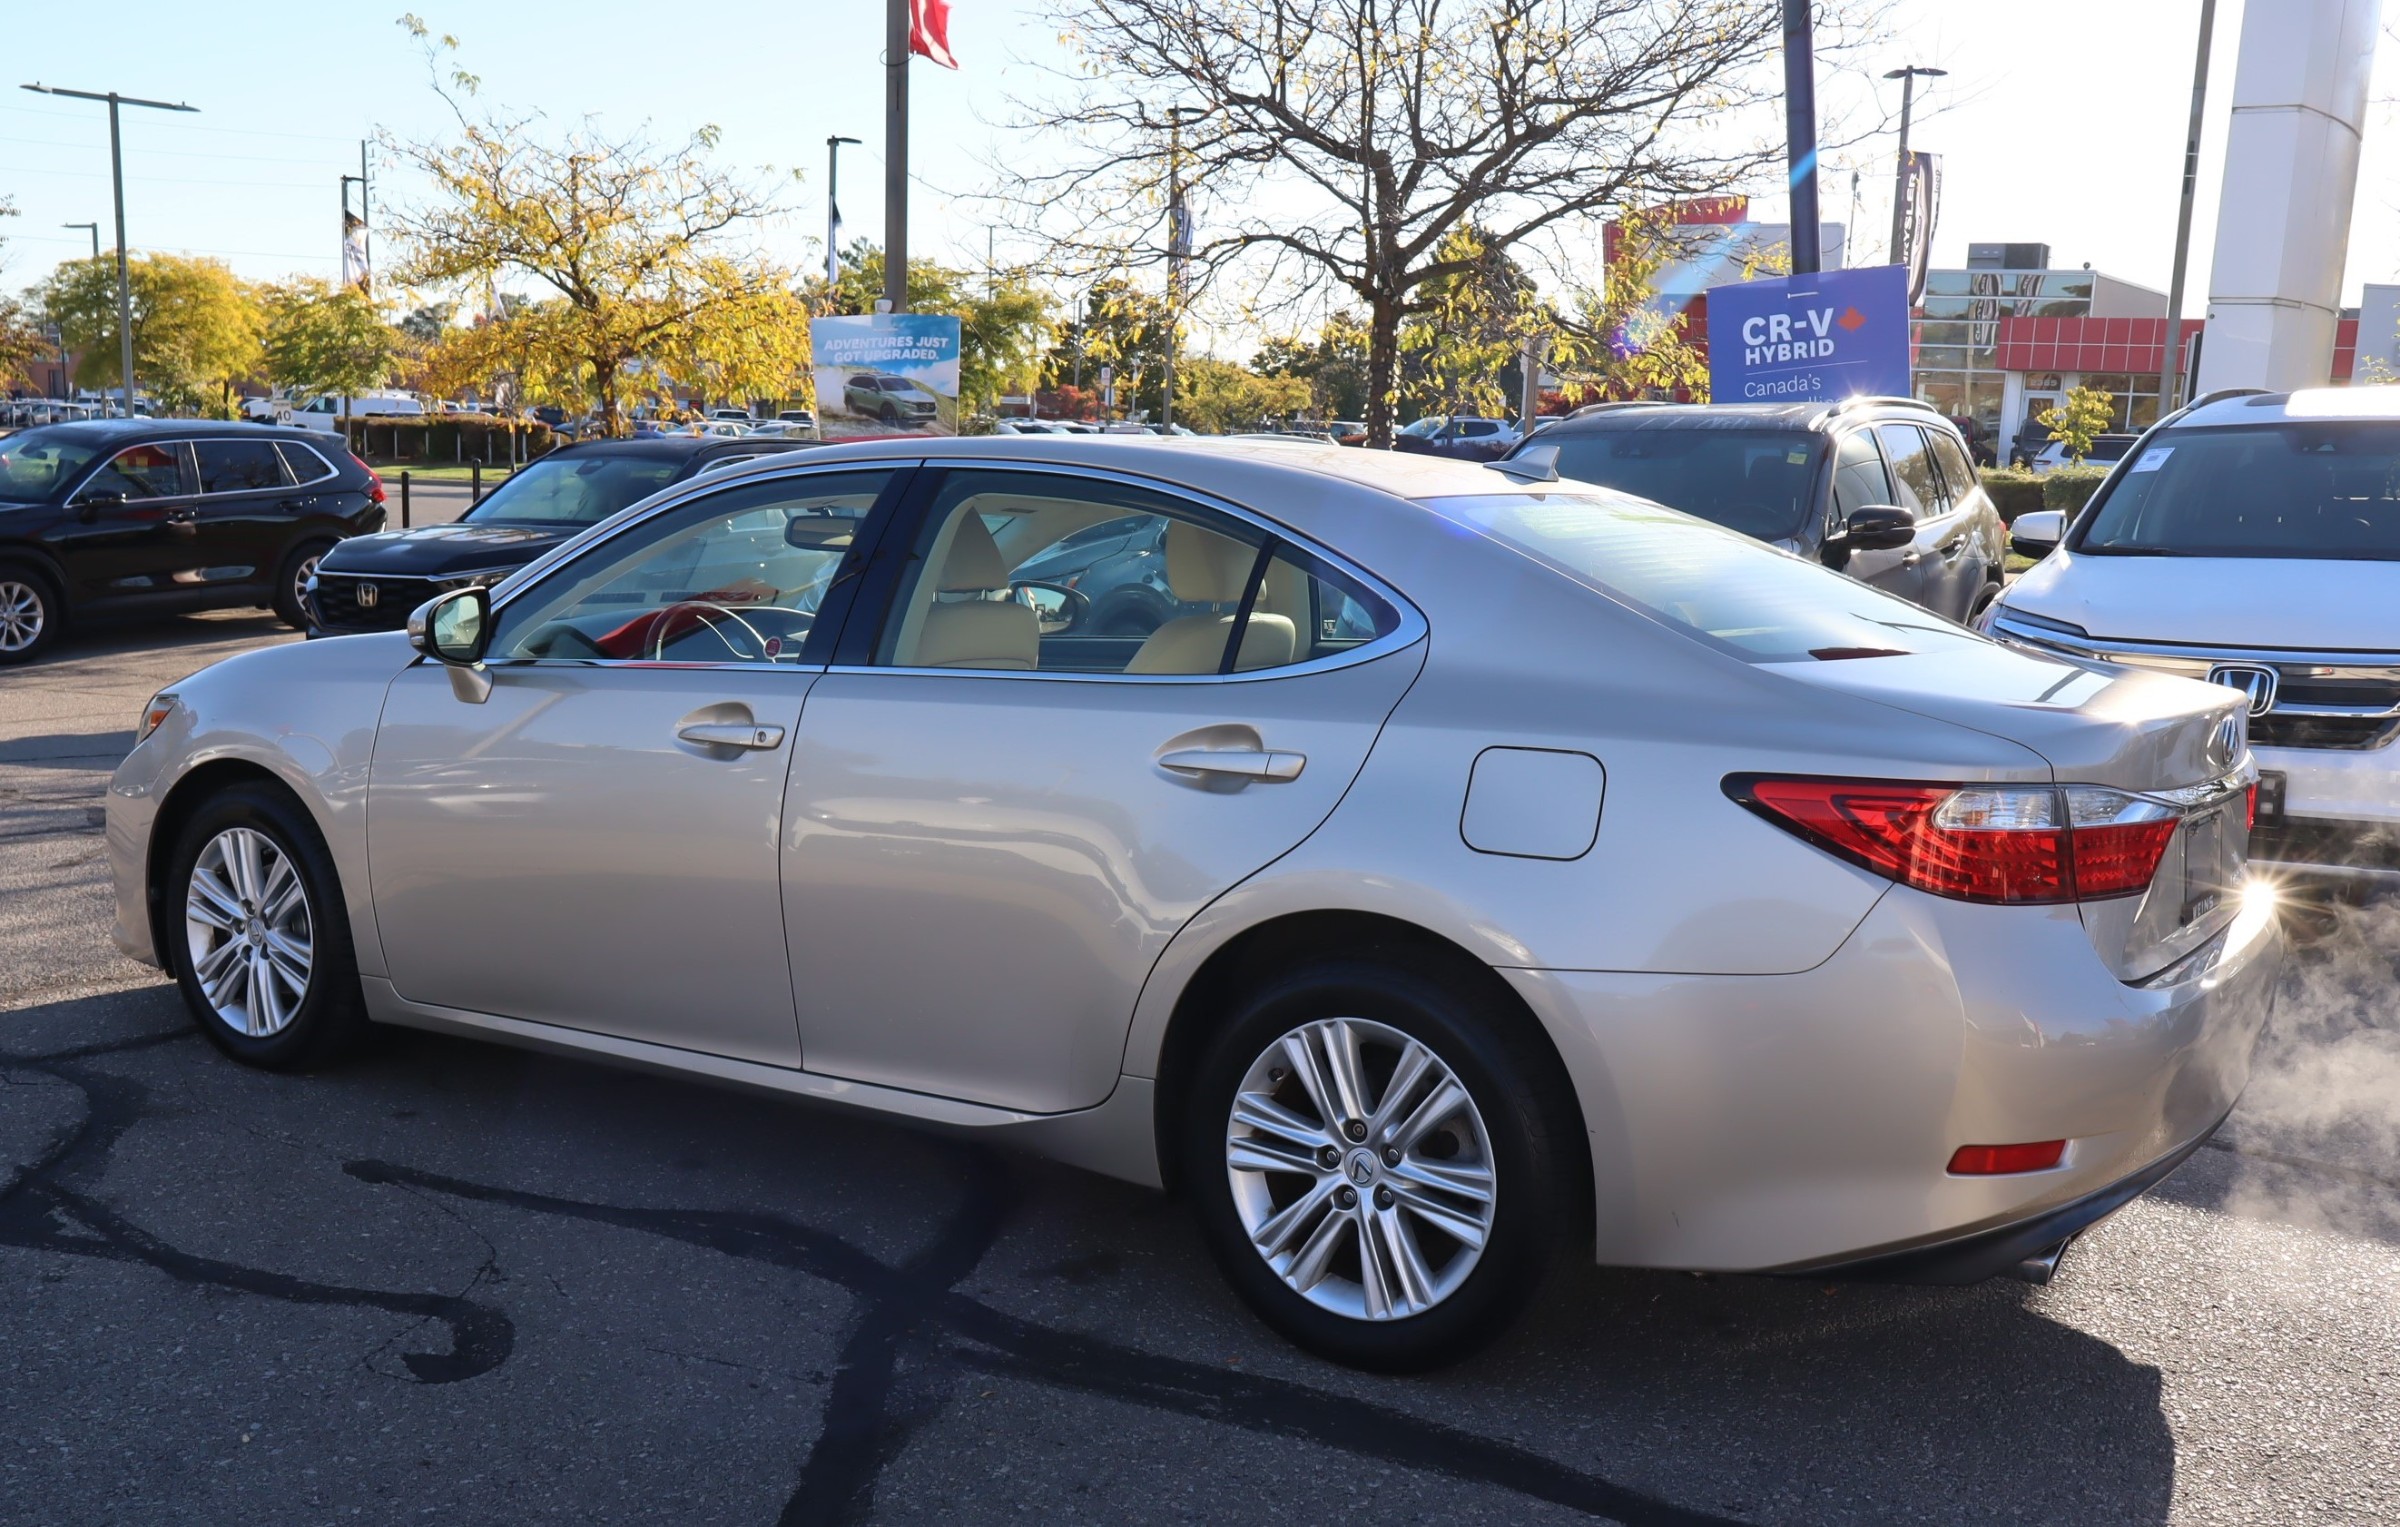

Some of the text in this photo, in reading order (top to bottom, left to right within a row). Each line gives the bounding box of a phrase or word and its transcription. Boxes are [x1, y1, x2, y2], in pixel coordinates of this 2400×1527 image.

[1742, 307, 1835, 346] CR-V
[824, 336, 949, 351] ADVENTURES JUST
[834, 348, 940, 363] GOT UPGRADED.
[1745, 339, 1835, 366] HYBRID
[1744, 373, 1822, 398] Canada's
